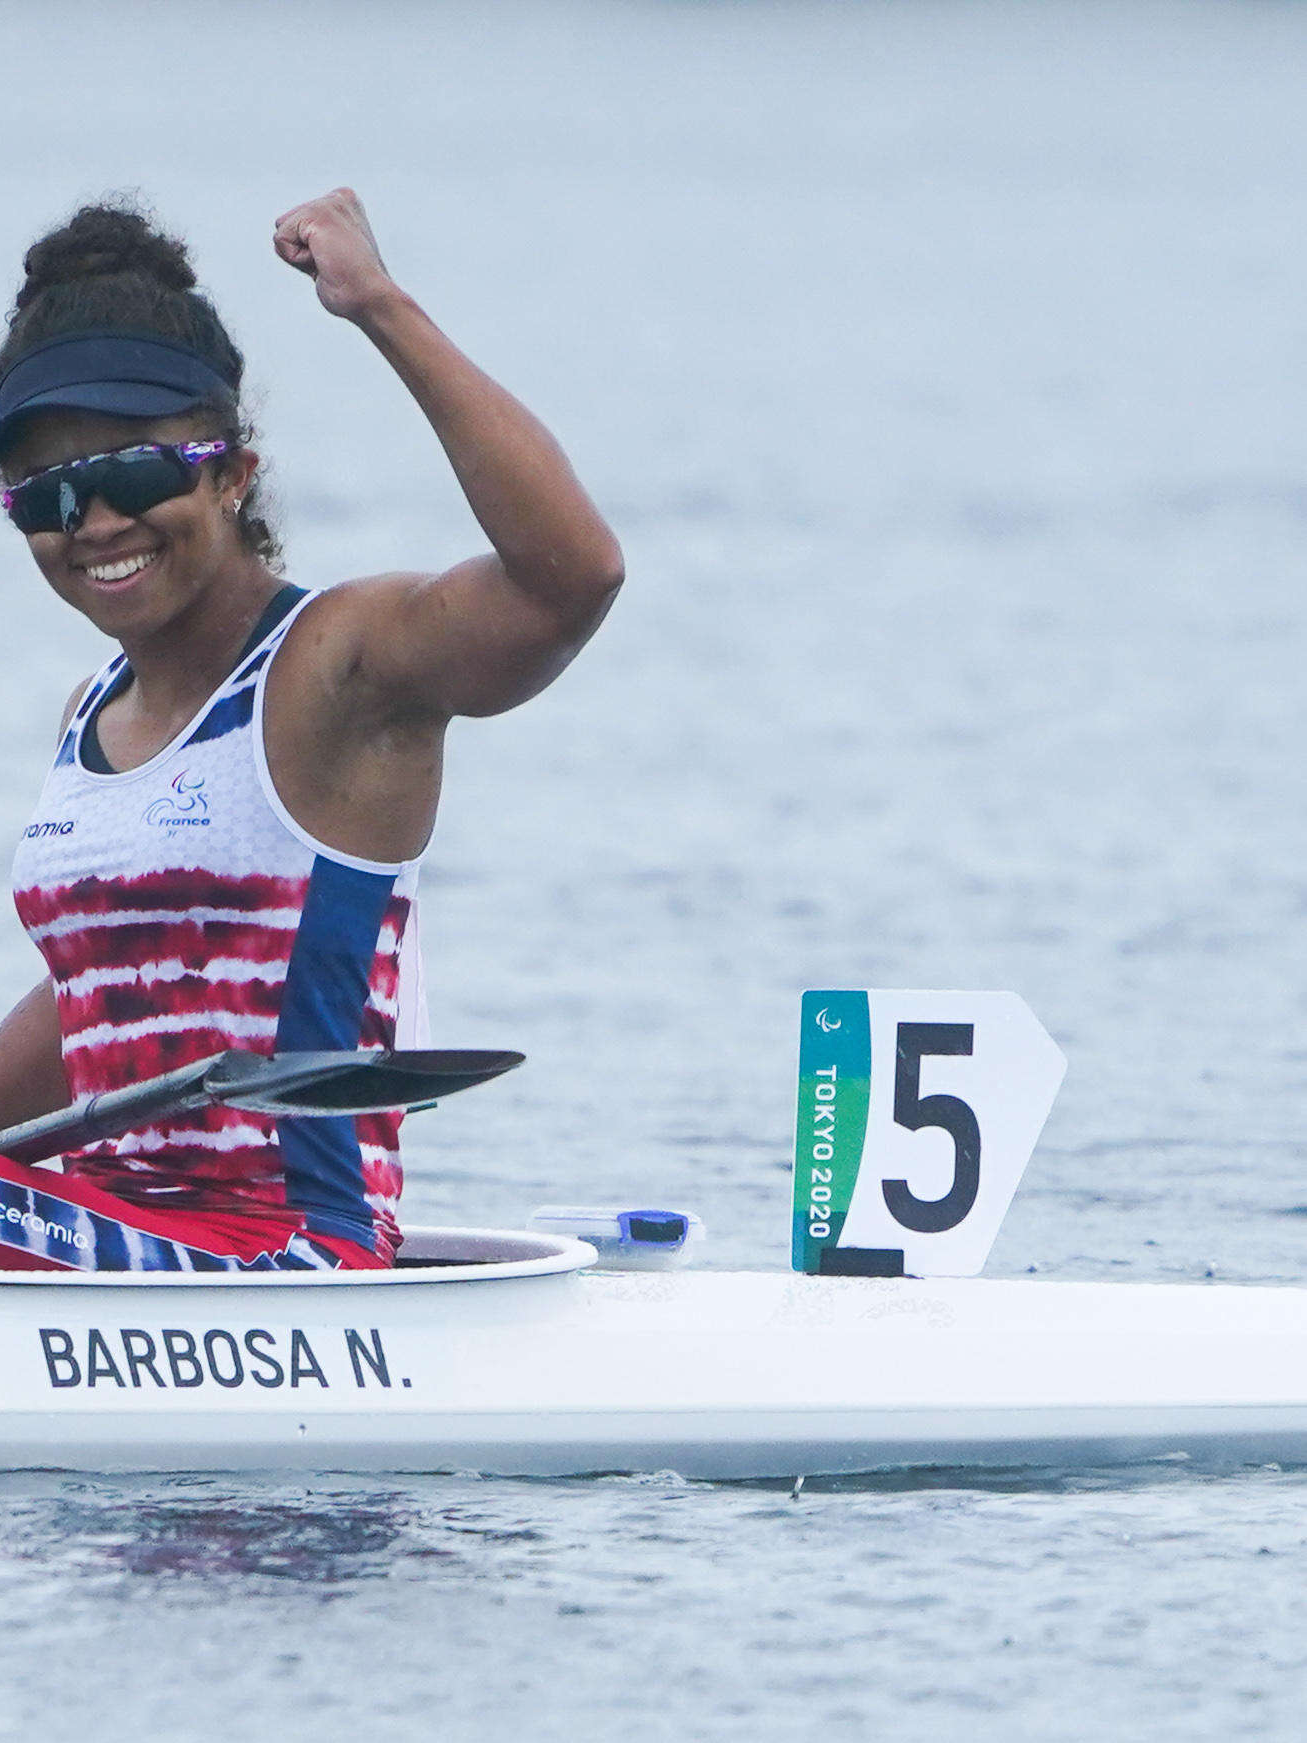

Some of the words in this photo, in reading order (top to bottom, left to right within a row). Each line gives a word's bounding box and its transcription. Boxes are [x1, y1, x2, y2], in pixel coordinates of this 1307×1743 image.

[812, 1065, 837, 1161] TOKYO
[881, 1022, 981, 1233] 5
[808, 1168, 833, 1239] 2020
[39, 1328, 329, 1388] BARBOSA
[343, 1328, 412, 1388] N.
